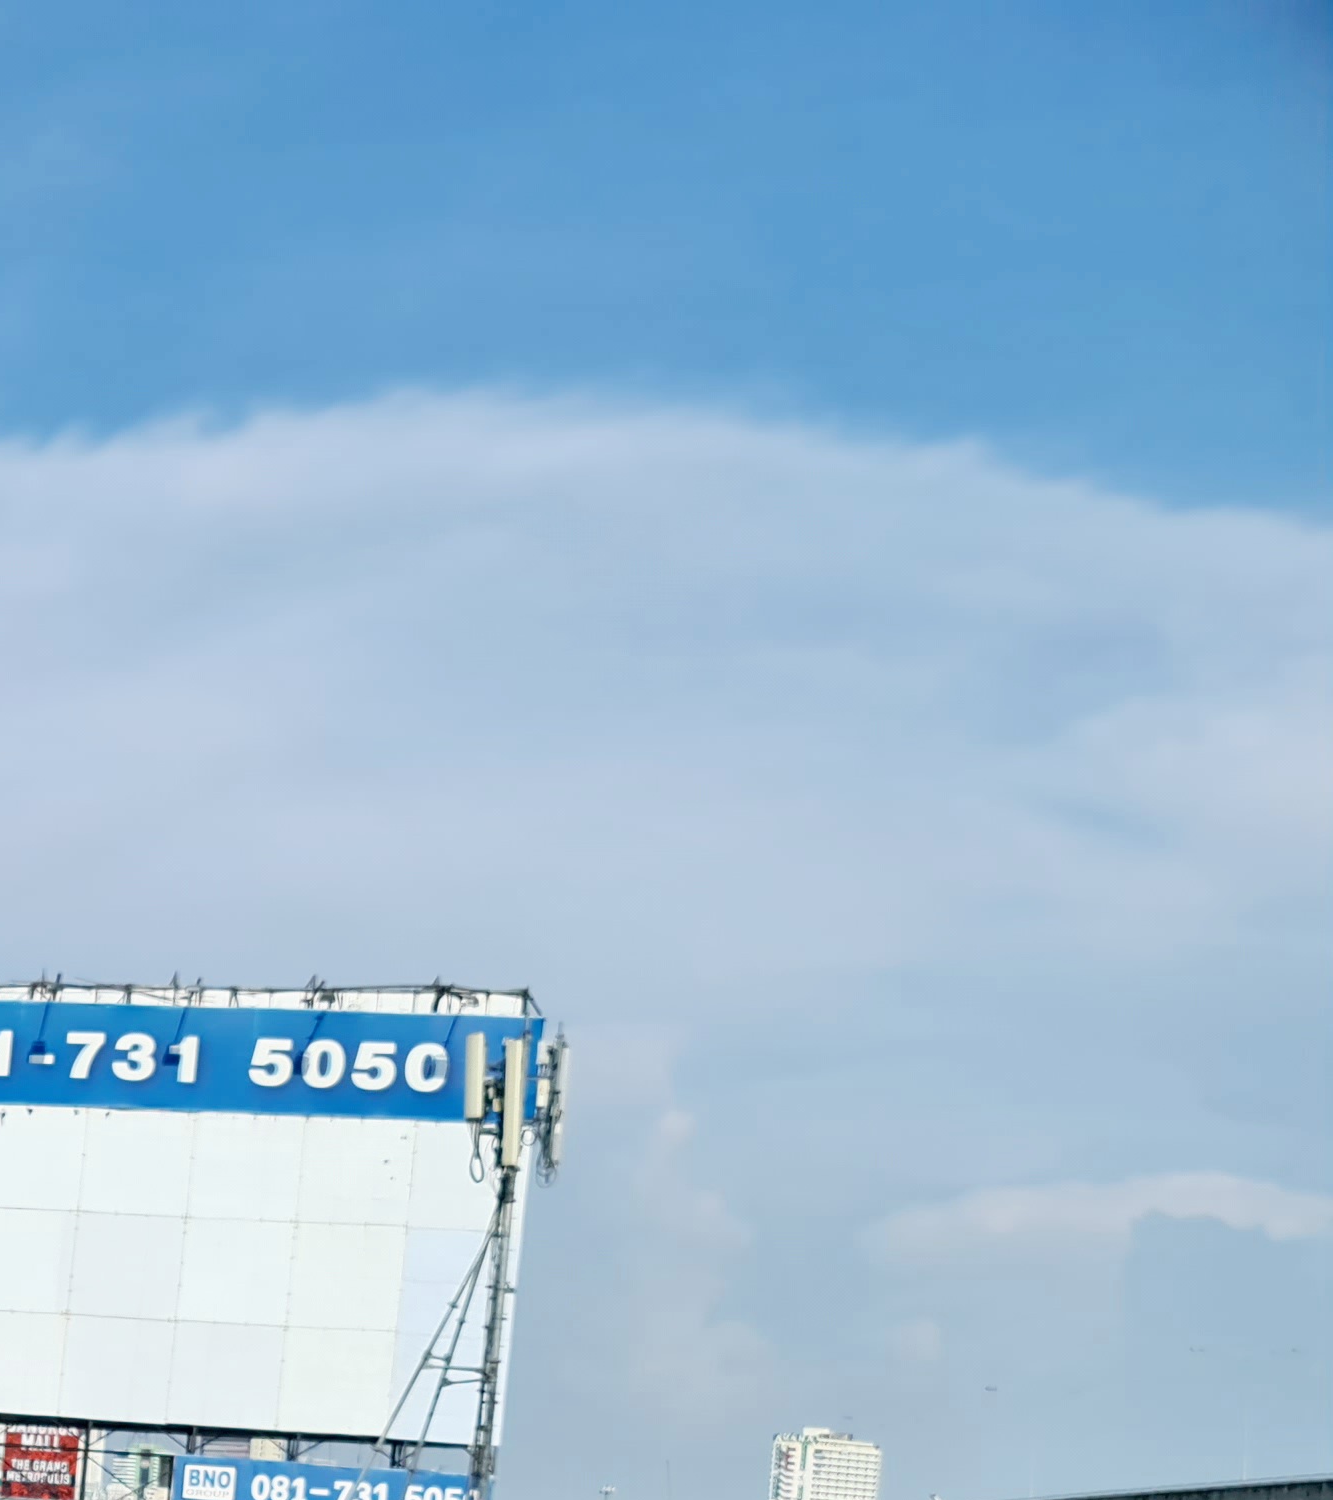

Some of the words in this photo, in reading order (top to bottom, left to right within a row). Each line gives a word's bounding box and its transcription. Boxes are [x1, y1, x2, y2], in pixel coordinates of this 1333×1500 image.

[248, 1037, 450, 1093] 5050
[11, 1458, 30, 1471] THE
[33, 1460, 69, 1473] GRAND
[188, 1469, 231, 1489] BNO
[185, 1489, 231, 1499] GROUP
